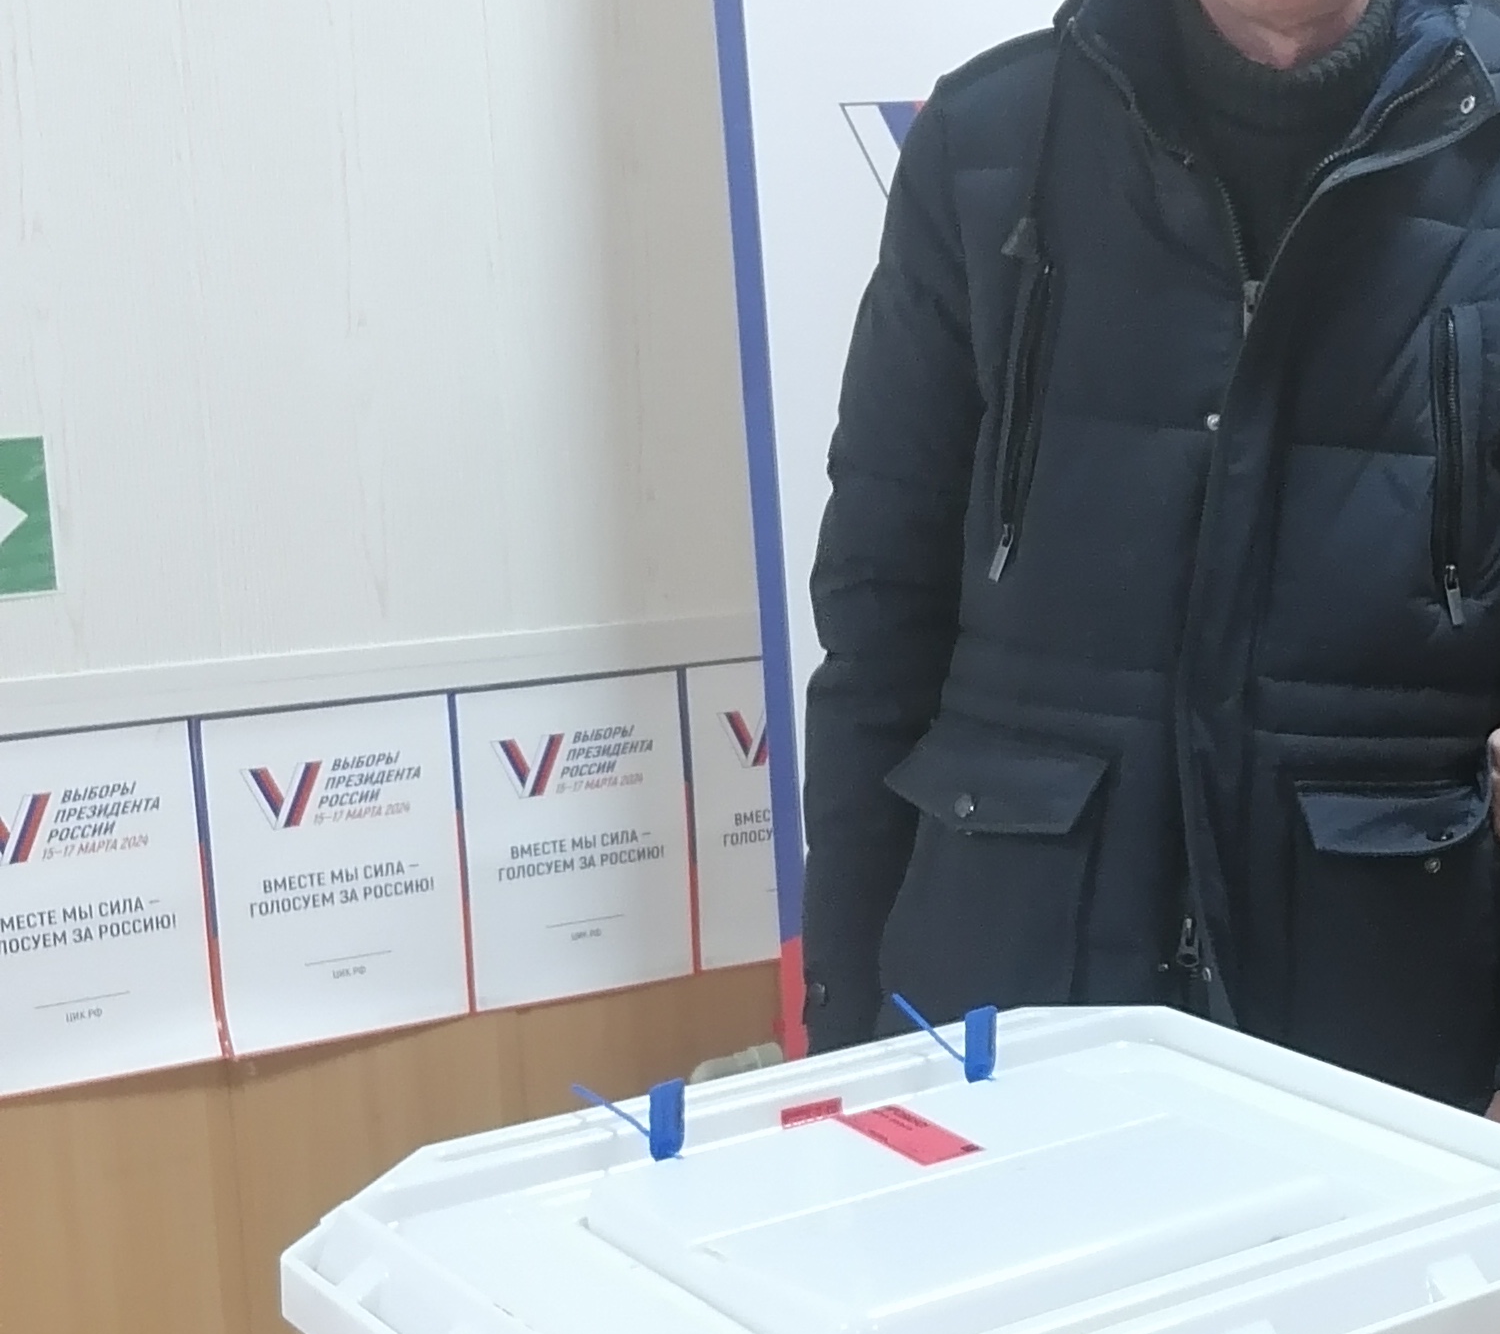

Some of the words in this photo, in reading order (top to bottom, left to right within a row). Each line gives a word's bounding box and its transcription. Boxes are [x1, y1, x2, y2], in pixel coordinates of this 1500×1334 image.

[572, 725, 635, 744] ВЫБОРЫ
[331, 751, 401, 771] ВЫБОРЫ
[566, 739, 653, 761] ПРЕЗИДЕНТА
[324, 766, 421, 790] ПРЕЗИДЕНТА
[560, 760, 617, 779] РОССИИ
[61, 781, 137, 804] ВЫБОРЫ
[318, 788, 381, 809] РОССИИ
[54, 796, 161, 824] ПРЕЗИДЕНТА
[345, 805, 382, 821] МАРТА
[734, 808, 771, 827] ВМЕС
[47, 820, 116, 843] РОССИИ
[723, 828, 773, 848] ГОЛОСУ
[77, 838, 118, 856] МАРТА
[120, 834, 149, 851] 2024
[510, 839, 567, 860] ВМЕСТЕ
[571, 834, 596, 851] МЫ
[601, 829, 639, 847] СИЛА
[498, 857, 575, 882] ГОЛОСУЕМ
[579, 854, 597, 871] ЗА
[600, 845, 665, 866] РОССИЮ!
[262, 872, 326, 894] ВМЕСТЕ
[330, 866, 359, 885] МЫ
[363, 860, 405, 880] СИЛА
[249, 891, 335, 918] ГОЛОСУЕМ
[339, 888, 359, 905] ЗА
[363, 876, 435, 900] РОССИЮ!
[0, 909, 57, 933] МЕСТЕ
[62, 903, 94, 923] МЫ
[98, 896, 144, 917] СИЛА
[0, 930, 68, 956] ЛОСУЕМ
[72, 926, 94, 944] ЗА
[98, 913, 177, 940] РОССИЮ!
